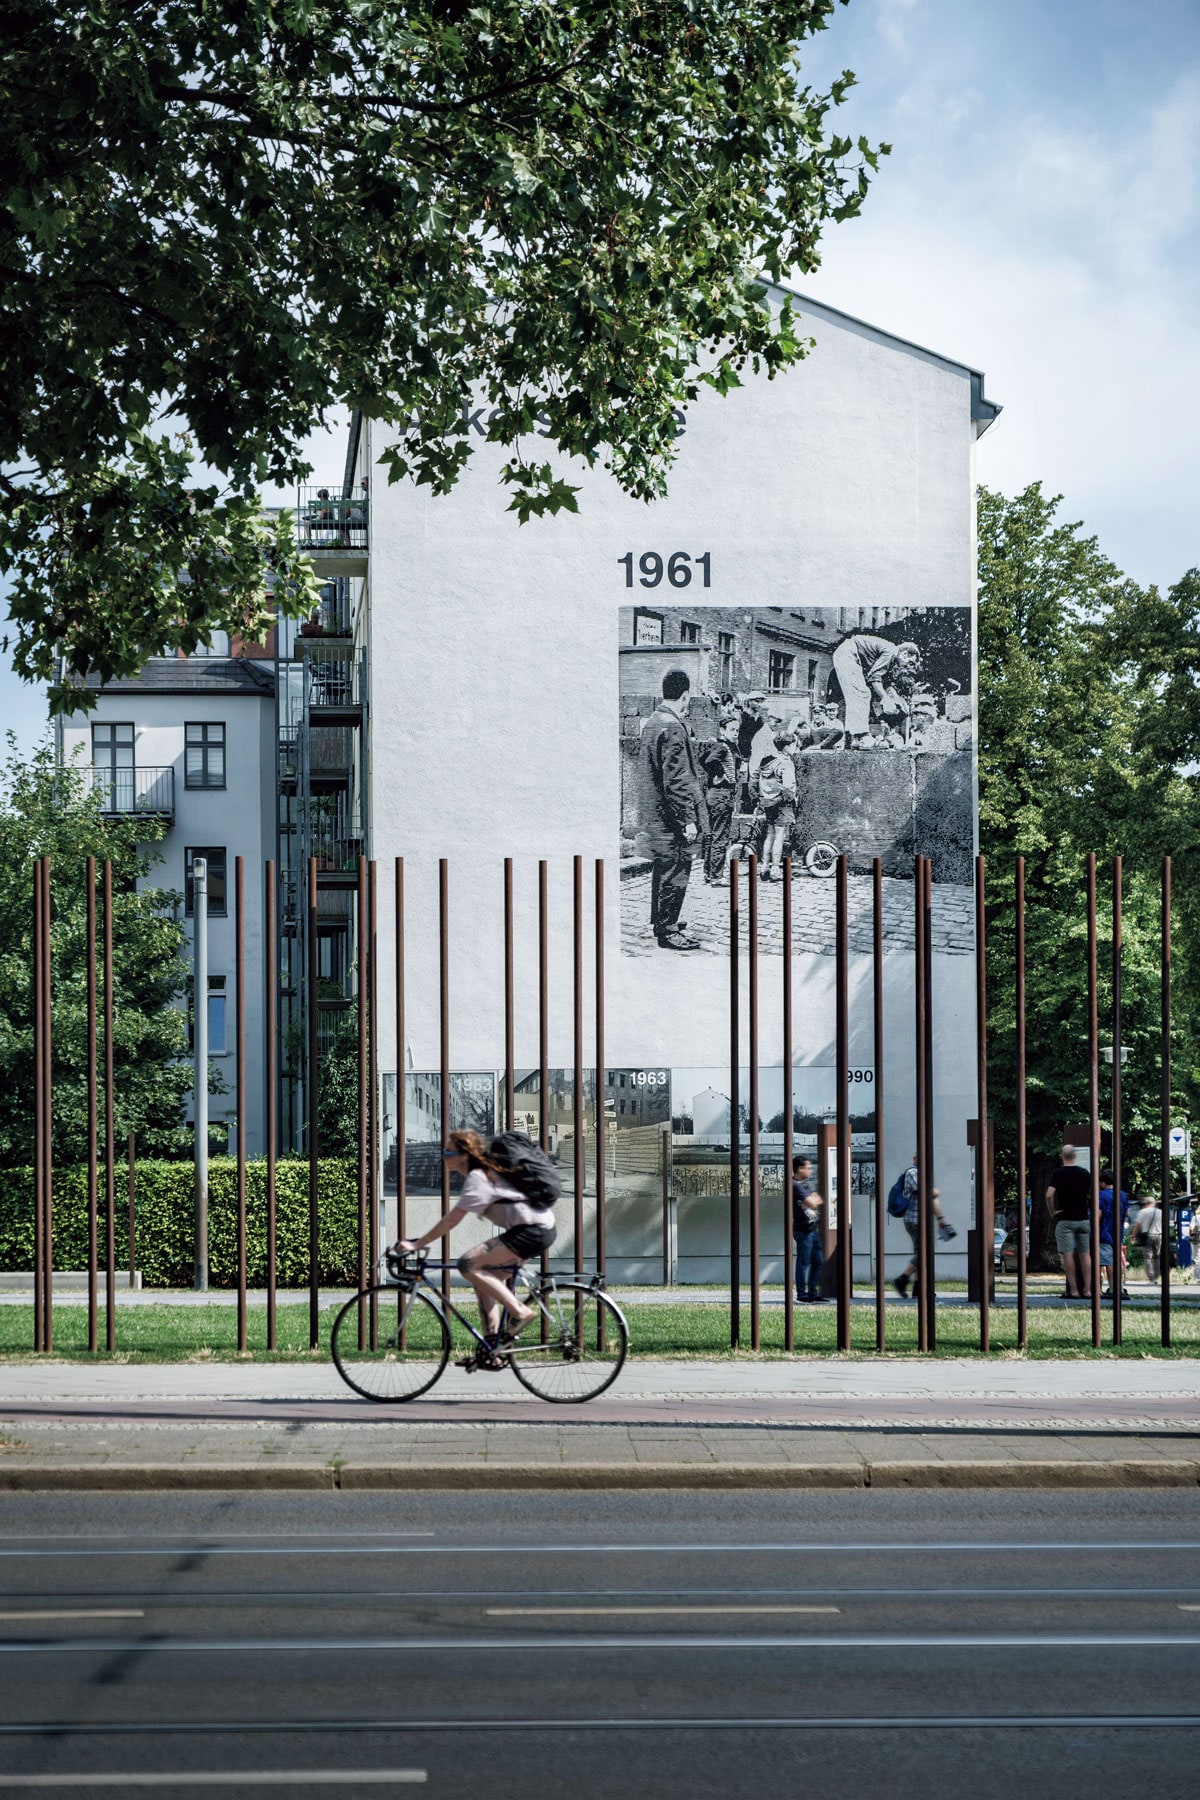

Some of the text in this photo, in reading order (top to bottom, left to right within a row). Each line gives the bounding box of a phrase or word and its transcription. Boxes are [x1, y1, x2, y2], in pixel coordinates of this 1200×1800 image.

[617, 552, 711, 588] 1961
[630, 1071, 667, 1085] 1963
[847, 1070, 873, 1083] 990
[455, 1078, 493, 1091] 1963
[1182, 1210, 1188, 1218] P
